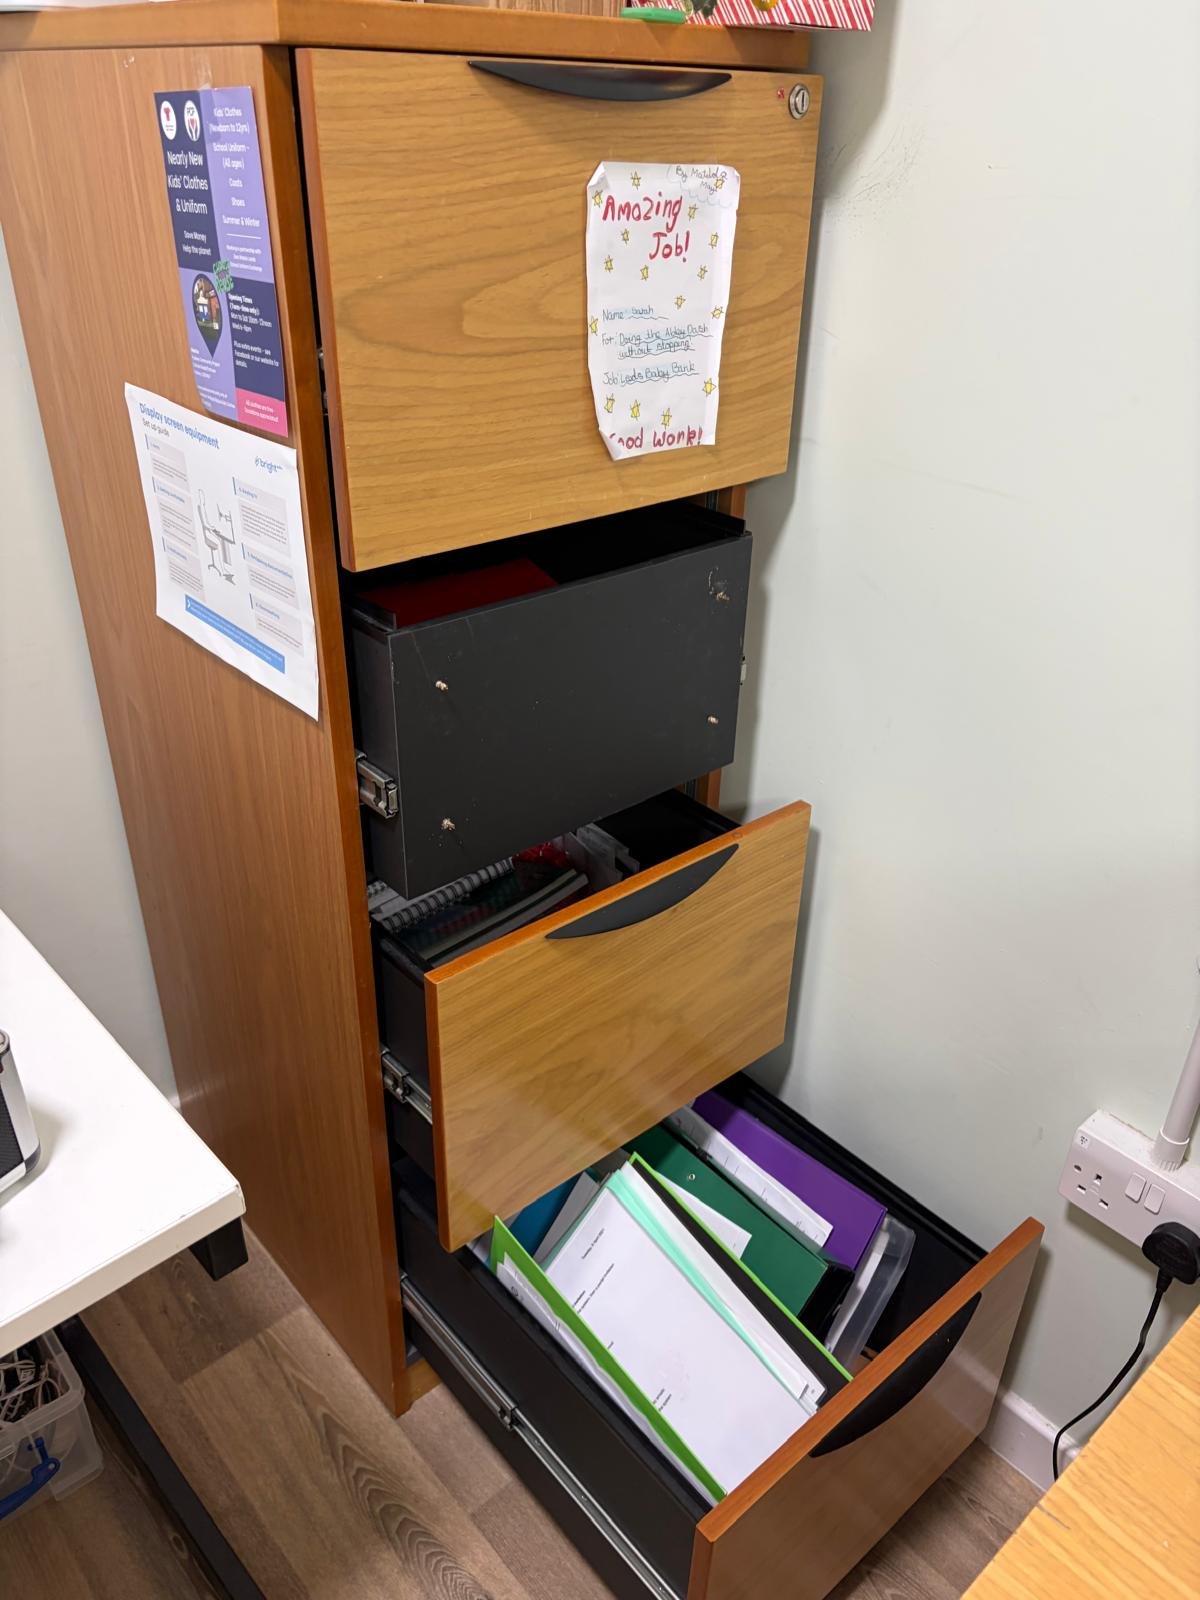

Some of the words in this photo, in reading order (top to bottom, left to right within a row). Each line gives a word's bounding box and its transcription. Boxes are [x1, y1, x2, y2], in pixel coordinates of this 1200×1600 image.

[167, 151, 189, 168] Nearly
[189, 152, 203, 166] New
[168, 174, 182, 189] Kids'
[184, 175, 208, 190] Clothes
[229, 178, 243, 188] Coats
[175, 199, 181, 212] &
[181, 199, 208, 214] Uniform
[231, 196, 246, 207] Shoes
[602, 191, 683, 233] Amazing
[649, 230, 690, 263] Job!
[139, 402, 163, 424] Display
[164, 416, 184, 432] screen
[185, 426, 220, 450] equipment
